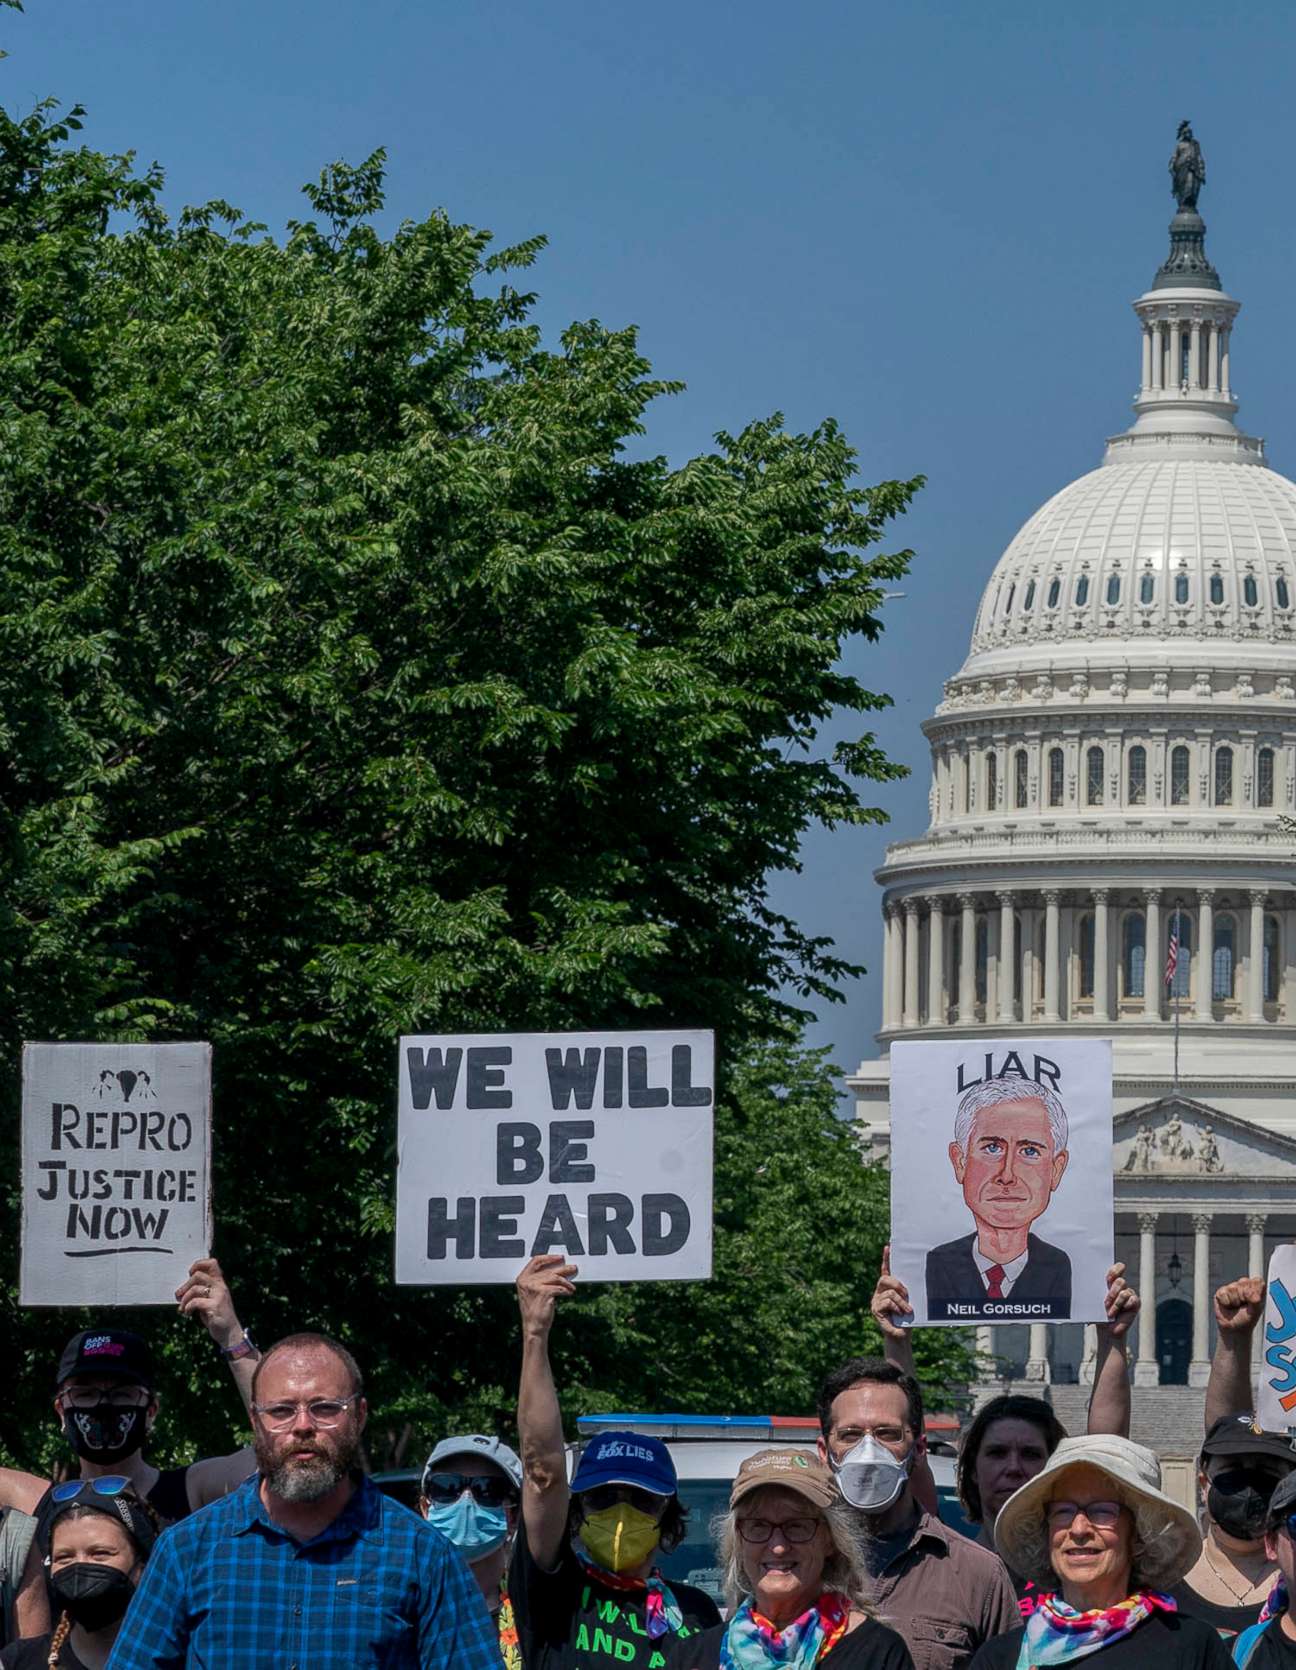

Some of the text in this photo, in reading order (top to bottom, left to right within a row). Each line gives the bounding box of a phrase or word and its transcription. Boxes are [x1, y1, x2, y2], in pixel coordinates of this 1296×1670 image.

[407, 1044, 712, 1110] WE WILL
[957, 1051, 1062, 1095] LIAR
[51, 1103, 192, 1150] REPRO
[497, 1120, 595, 1185] BE
[37, 1160, 197, 1202] JUSTICE
[66, 1204, 170, 1240] NOW
[427, 1192, 691, 1260] HEARD
[947, 1303, 1051, 1315] NEIL GORSUCH
[626, 1446, 654, 1462] LIES
[582, 1586, 591, 1609] I
[576, 1624, 636, 1662] AND
